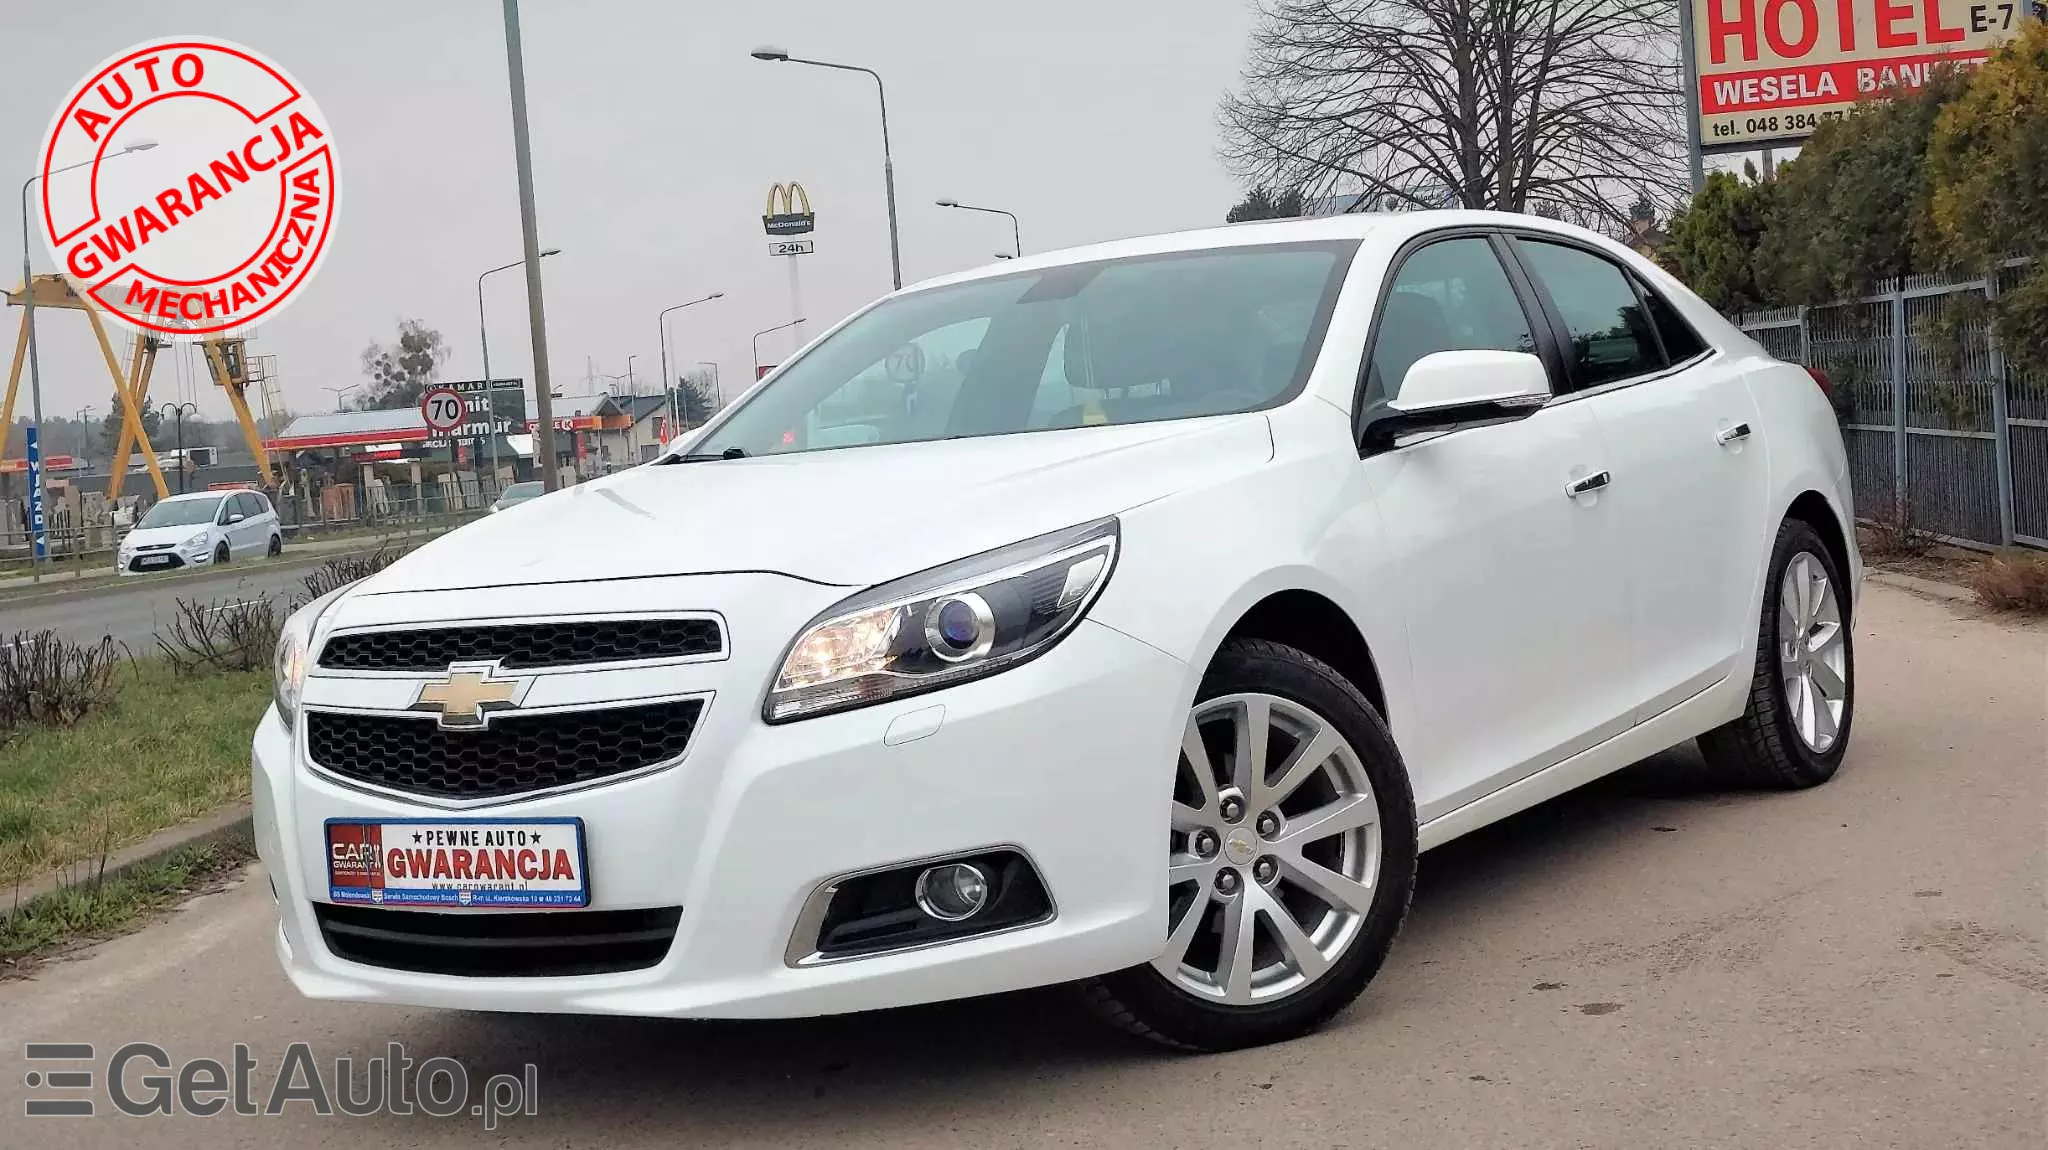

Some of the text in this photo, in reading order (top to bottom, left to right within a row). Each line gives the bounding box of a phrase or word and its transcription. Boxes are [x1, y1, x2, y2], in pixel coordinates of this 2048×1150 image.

[1707, 0, 2014, 64] HOTEL E-7
[1713, 71, 1839, 106] WESELA
[1713, 122, 1741, 137] tel.
[1746, 116, 1779, 134] 048
[1785, 112, 1817, 131] 384
[778, 243, 804, 253] 24h
[431, 399, 459, 420] 70
[426, 830, 527, 847] PEWNE AUTO
[386, 848, 575, 880] GWARANCJA
